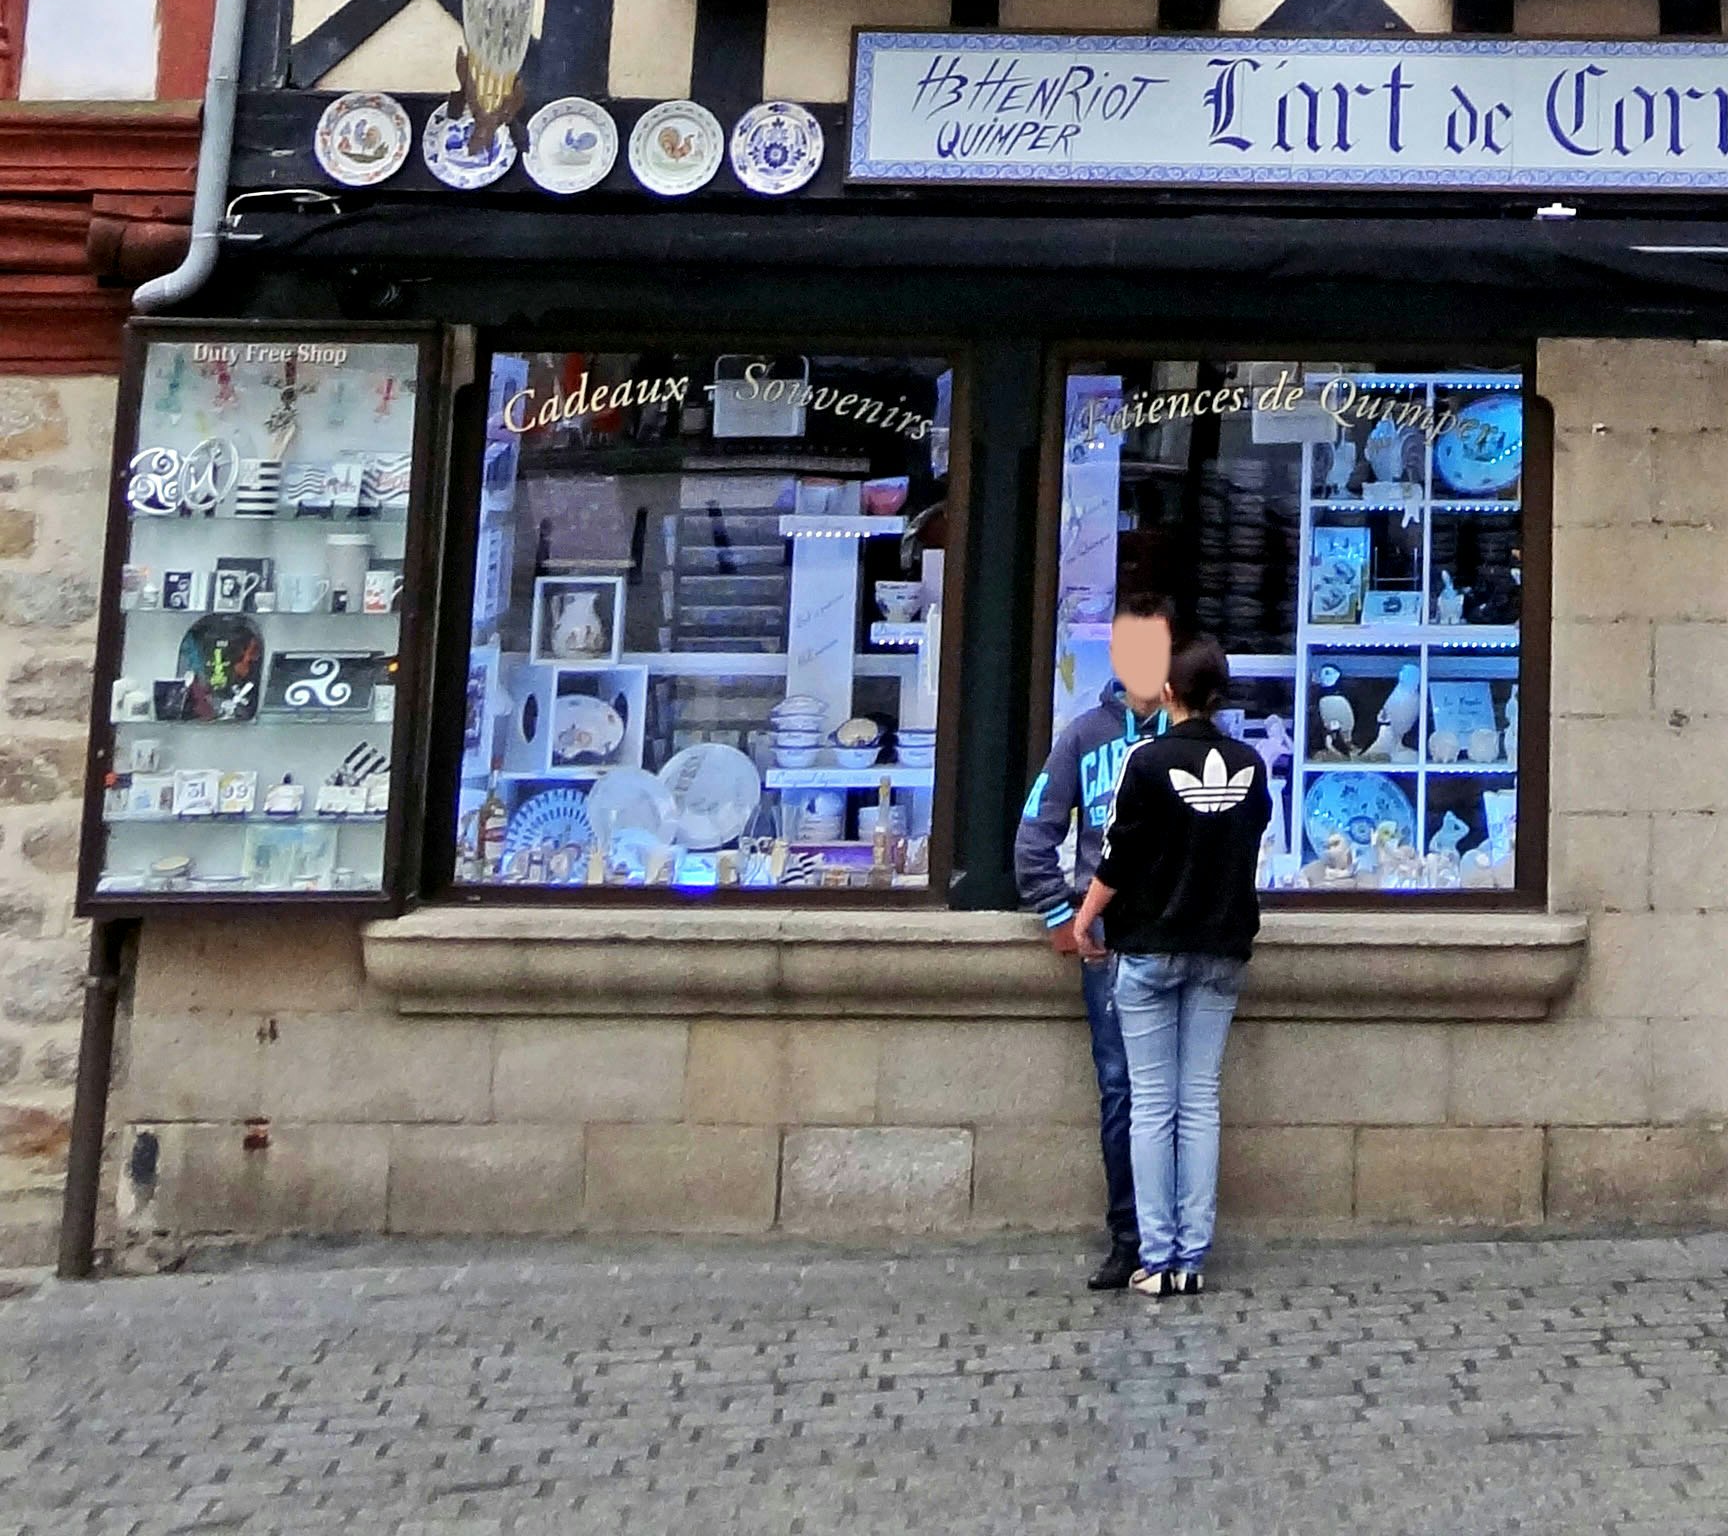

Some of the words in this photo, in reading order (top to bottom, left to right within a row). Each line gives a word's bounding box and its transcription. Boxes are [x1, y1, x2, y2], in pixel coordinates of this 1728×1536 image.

[1441, 84, 1513, 157] de
[193, 344, 240, 367] Duty
[245, 344, 293, 363] Free
[297, 343, 348, 367] Shop
[503, 372, 689, 434] Cadeaux
[736, 363, 937, 440] Souvenirs
[1076, 384, 1244, 443] Faïences
[1258, 371, 1300, 412] de
[1319, 378, 1499, 451] Quimper
